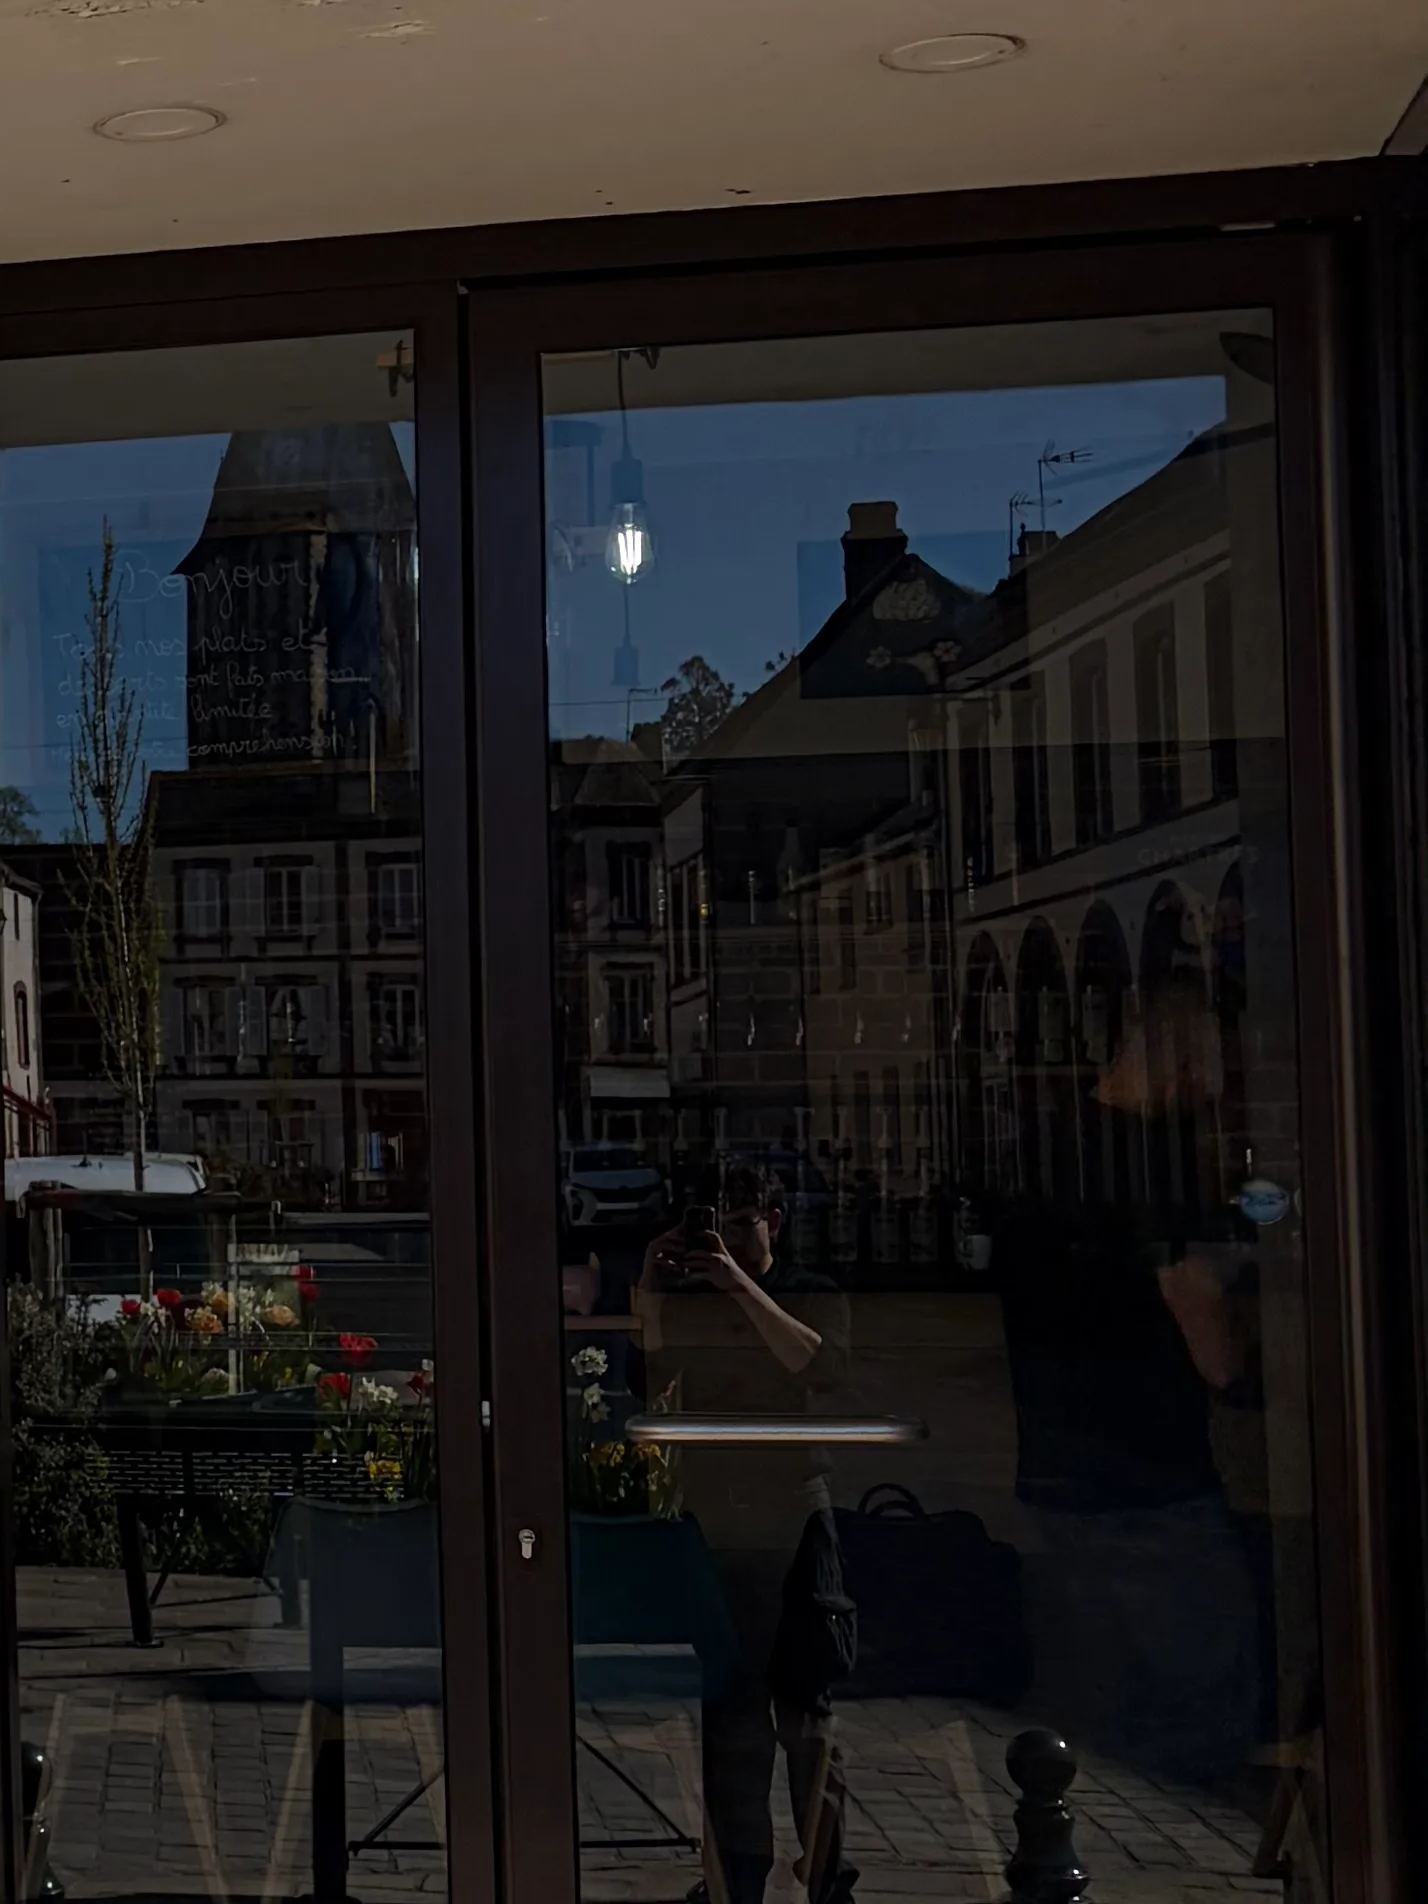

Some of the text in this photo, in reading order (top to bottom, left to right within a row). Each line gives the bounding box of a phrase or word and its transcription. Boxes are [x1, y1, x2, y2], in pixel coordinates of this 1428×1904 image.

[114, 549, 308, 619] Bonjour
[193, 624, 267, 666] plats
[282, 618, 315, 651] et
